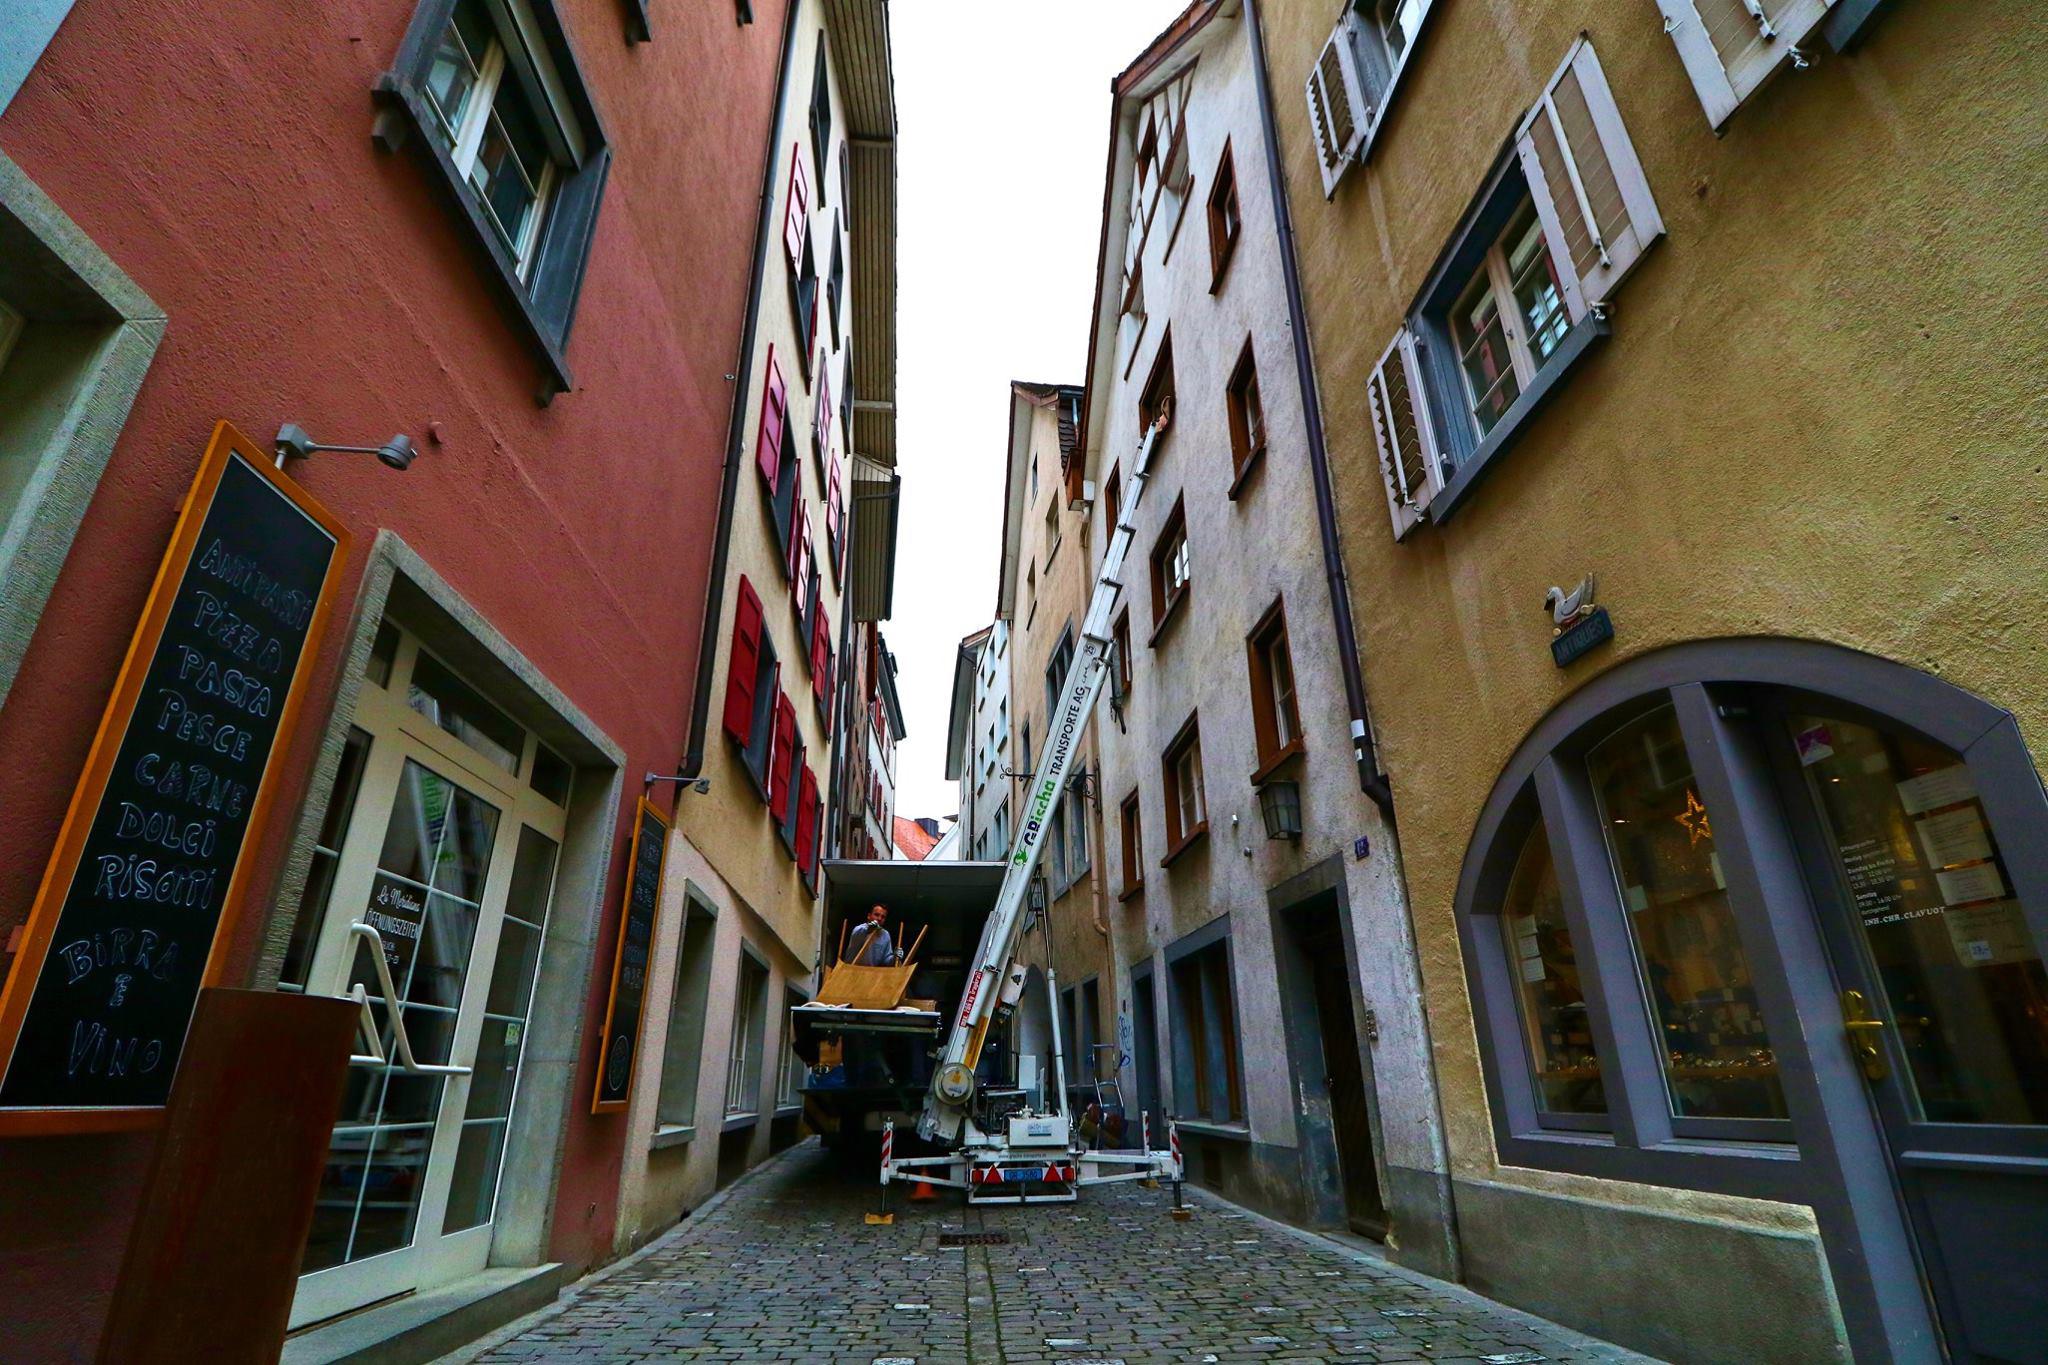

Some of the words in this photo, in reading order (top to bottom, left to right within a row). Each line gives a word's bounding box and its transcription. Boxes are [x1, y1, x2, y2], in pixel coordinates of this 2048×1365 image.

[178, 645, 271, 718] PASTA
[158, 688, 253, 761] PESCE
[1049, 702, 1081, 775] TRANSPORTE
[1072, 686, 1086, 704] AG
[135, 753, 248, 818] CARNE
